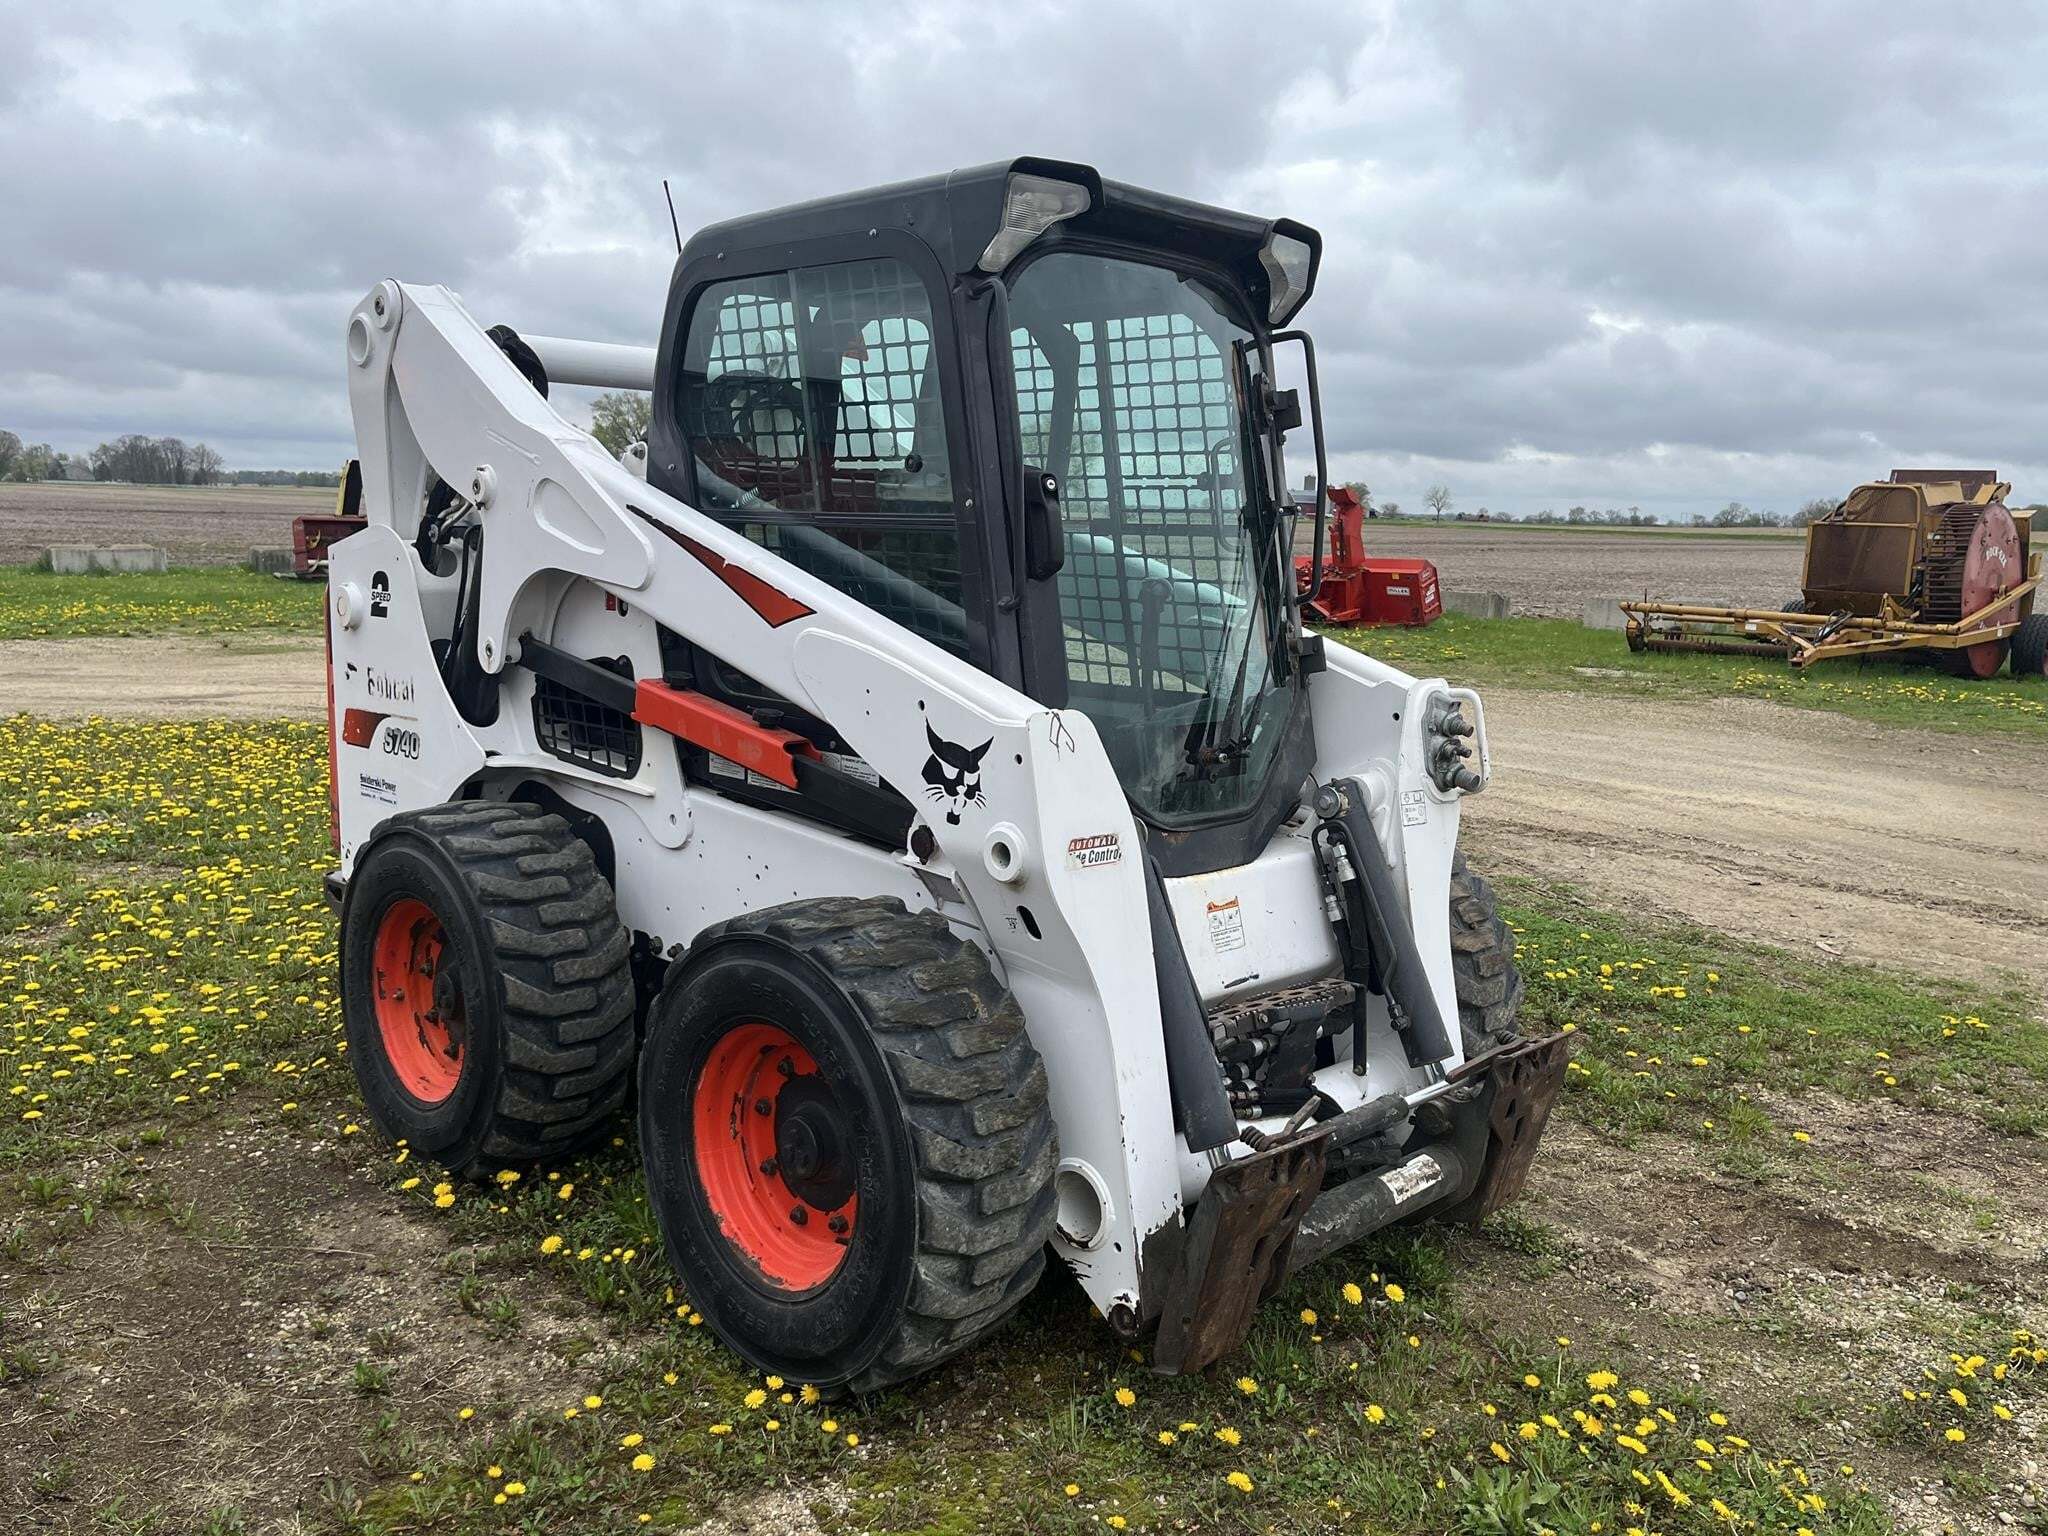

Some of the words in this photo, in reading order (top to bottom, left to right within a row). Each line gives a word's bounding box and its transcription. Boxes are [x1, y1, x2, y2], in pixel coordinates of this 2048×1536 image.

[370, 570, 390, 618] 2
[371, 591, 391, 602] SPEED
[383, 726, 420, 760] S740
[1069, 835, 1118, 851] AUTOMATI
